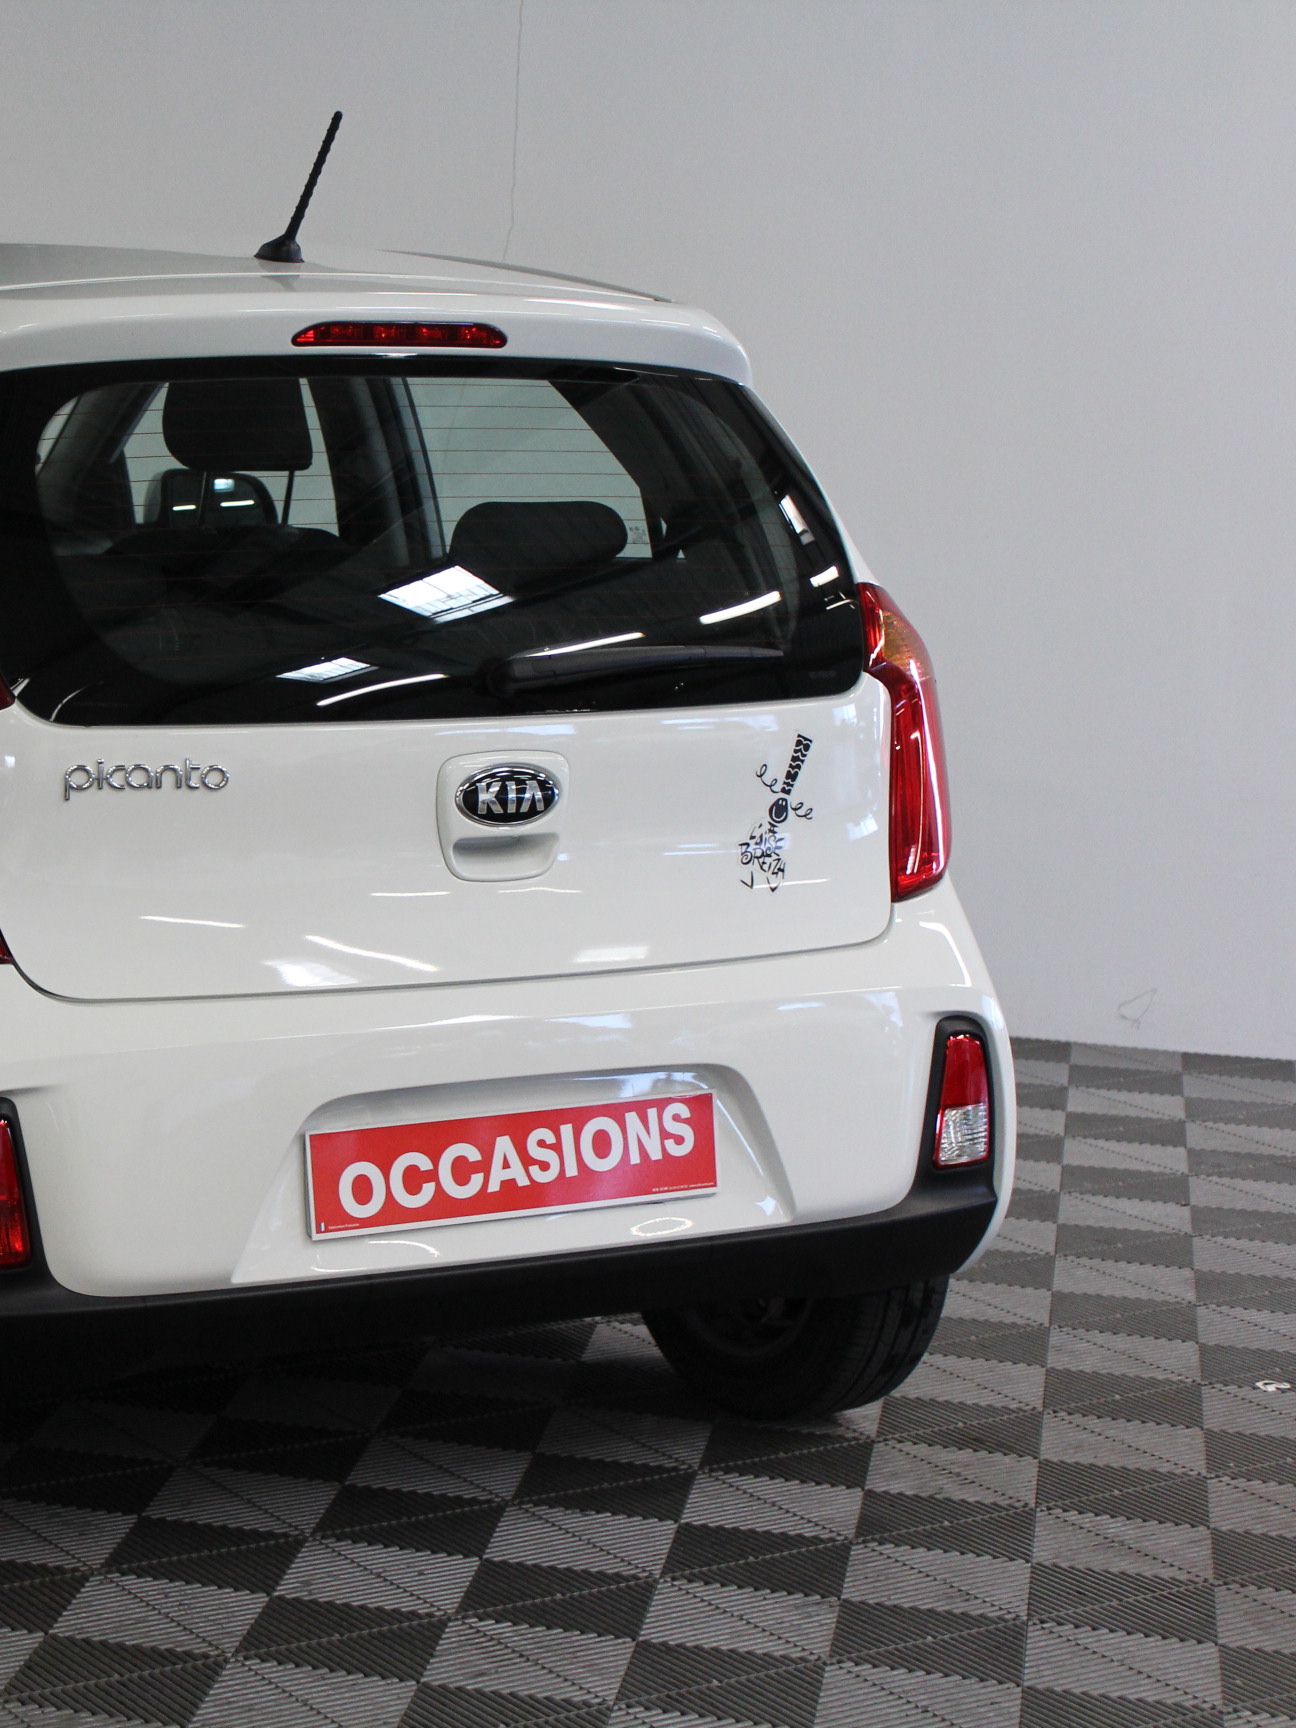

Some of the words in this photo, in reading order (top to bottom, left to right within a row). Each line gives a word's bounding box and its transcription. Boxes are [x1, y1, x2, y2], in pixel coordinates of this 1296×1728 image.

[64, 758, 230, 800] picanto
[476, 780, 545, 814] KIA
[338, 1102, 695, 1219] OCCASIONS
